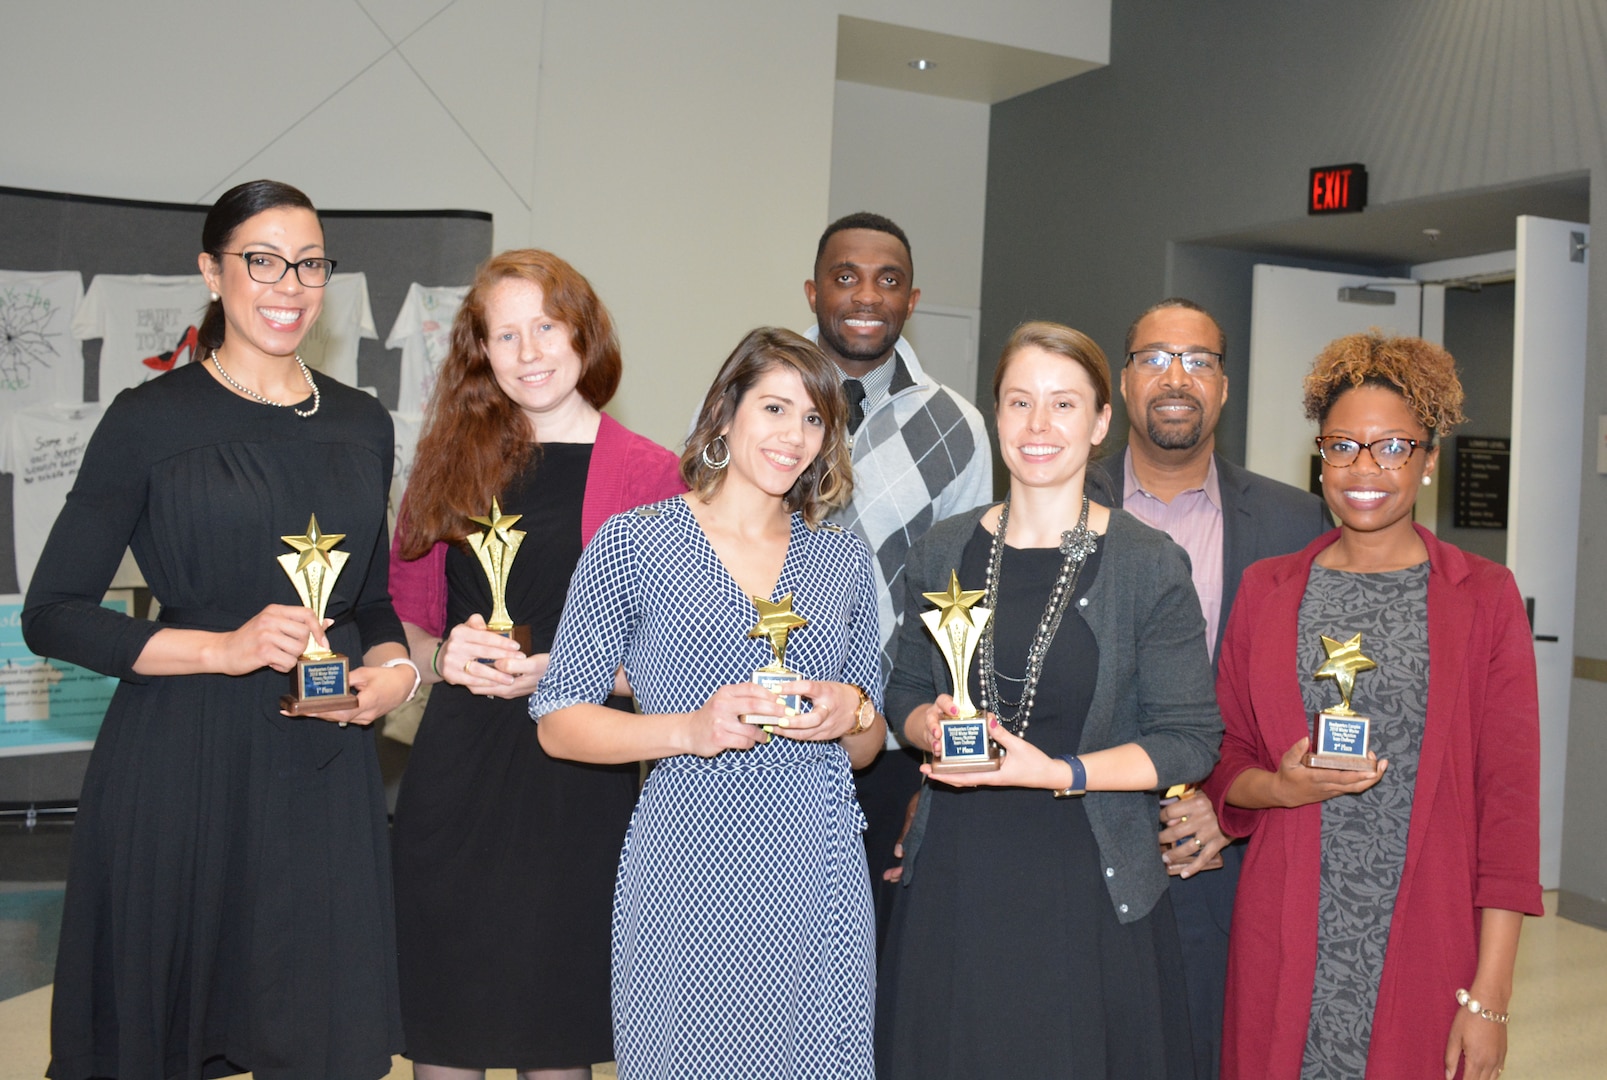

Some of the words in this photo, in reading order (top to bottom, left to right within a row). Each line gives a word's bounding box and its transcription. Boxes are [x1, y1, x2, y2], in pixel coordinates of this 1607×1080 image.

[1313, 169, 1352, 210] EXIT
[34, 436, 61, 451] Some
[67, 432, 79, 445] of
[962, 746, 974, 754] Place
